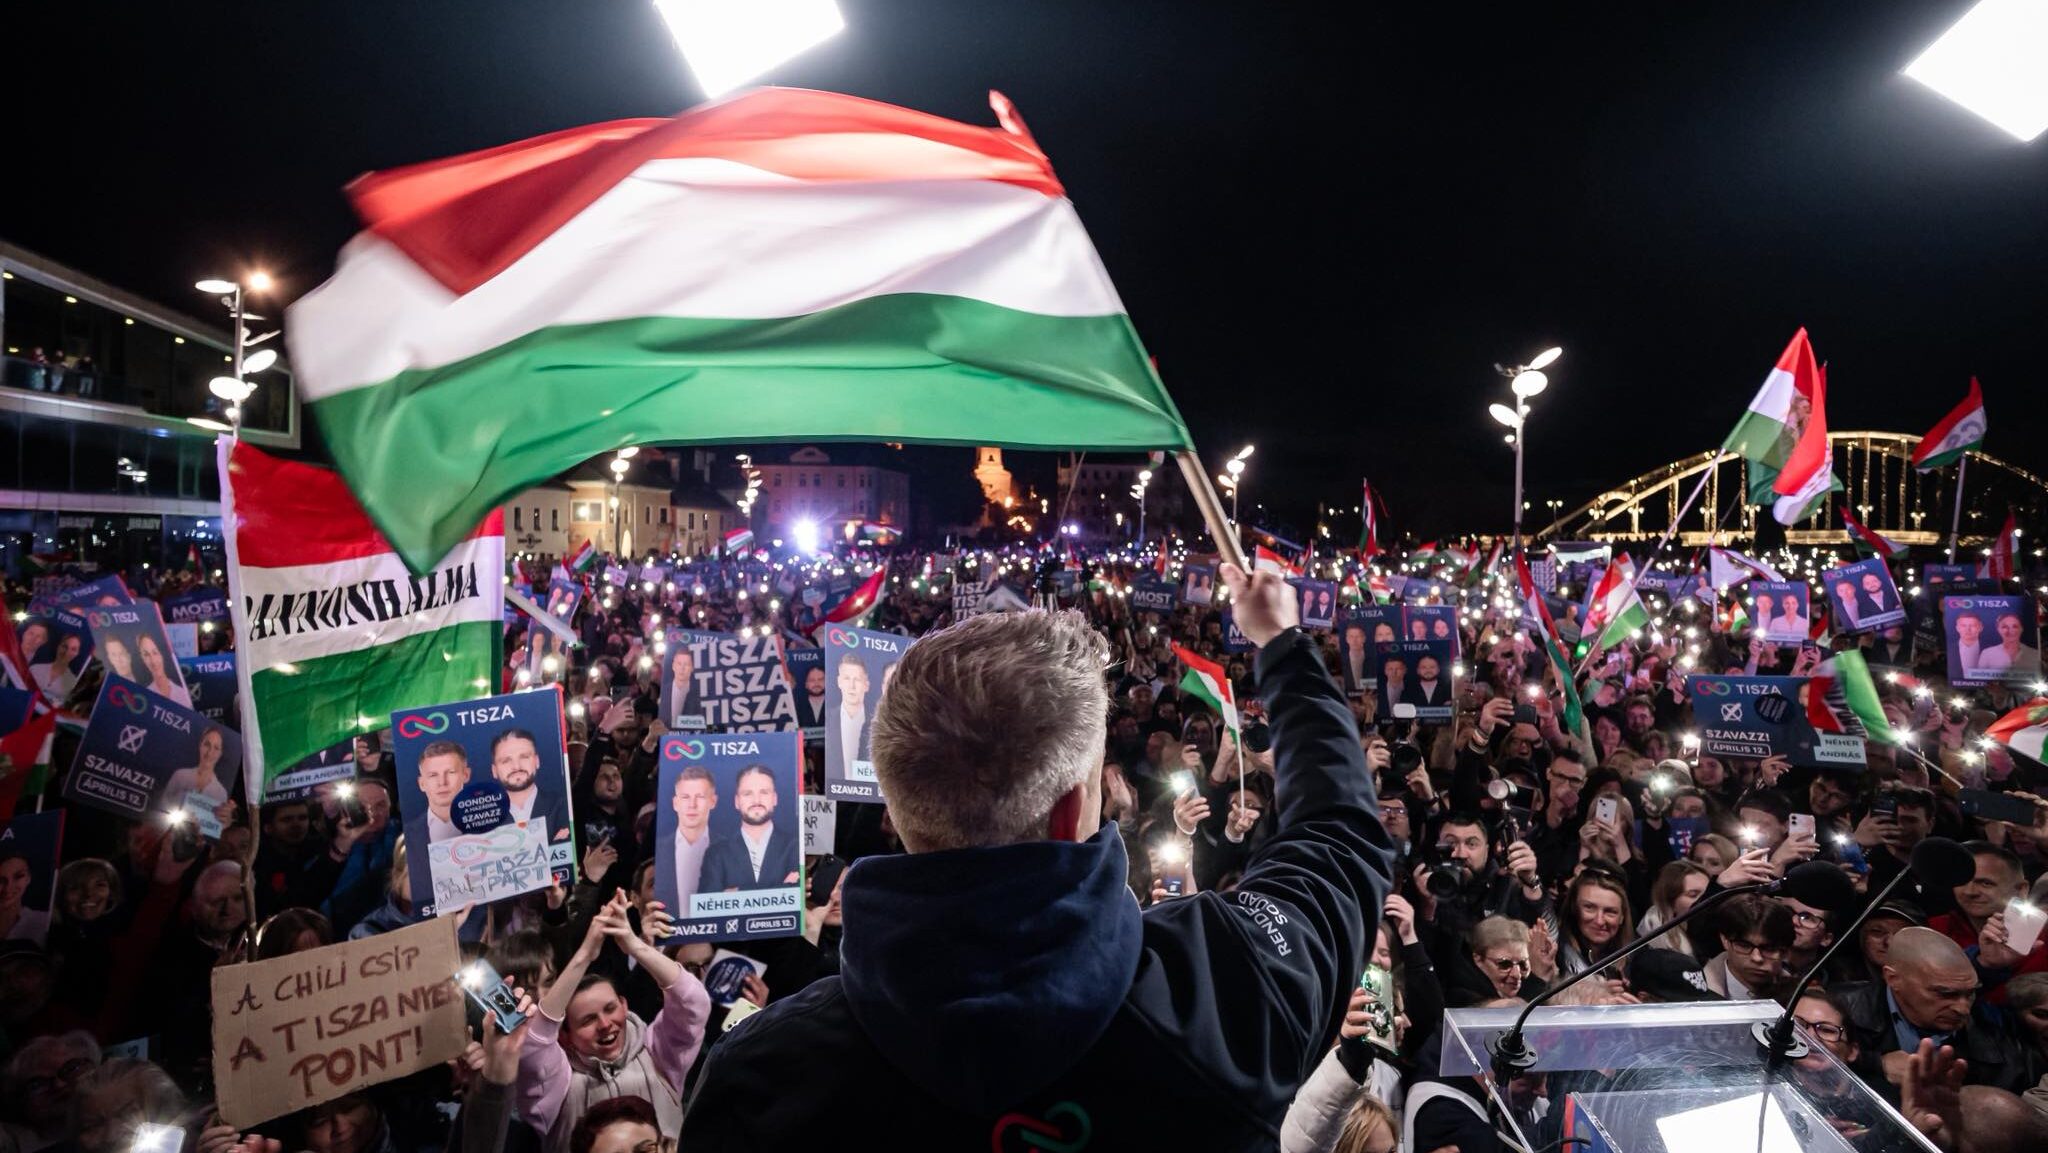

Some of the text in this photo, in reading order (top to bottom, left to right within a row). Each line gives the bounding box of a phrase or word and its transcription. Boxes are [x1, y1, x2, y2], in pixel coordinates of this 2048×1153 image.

[1133, 590, 1172, 604] MOST
[1977, 600, 2010, 608] TISZA
[172, 599, 221, 619] MOST
[1360, 609, 1384, 618] TISZA
[689, 634, 782, 669] TISZA
[863, 636, 898, 653] TISZA
[793, 653, 819, 661] TISZA
[196, 660, 233, 673] TISZA
[694, 664, 788, 697] TISZA
[1735, 683, 1782, 695] TISZA
[457, 704, 515, 727] TISZA
[701, 693, 796, 726] TISZA
[152, 705, 191, 734] TISZA
[1705, 728, 1770, 743] SZAVAZZ!
[1824, 736, 1859, 747] NÉHER
[711, 741, 760, 756] TISZA
[1712, 741, 1750, 754] ÁPRILIS
[1819, 748, 1862, 760] ANDRÁS
[84, 754, 155, 790] SZAVAZZ!
[82, 777, 127, 800] ÁPRILIS
[831, 784, 872, 796] SZAVAZZ!
[458, 793, 502, 809] GONDOLJ
[804, 800, 833, 813] YUNK
[462, 808, 501, 824] SZAVAZZ
[804, 816, 818, 829] AR
[697, 894, 796, 911] NÉHER ANDRÁS
[1238, 891, 1288, 925] SQUAD
[674, 919, 793, 937] AVAZZ! ÁPRILIS 12.
[231, 983, 264, 1016] A
[230, 1036, 267, 1072] A
[272, 995, 389, 1053] TISZA
[289, 1025, 424, 1099] PONT!
